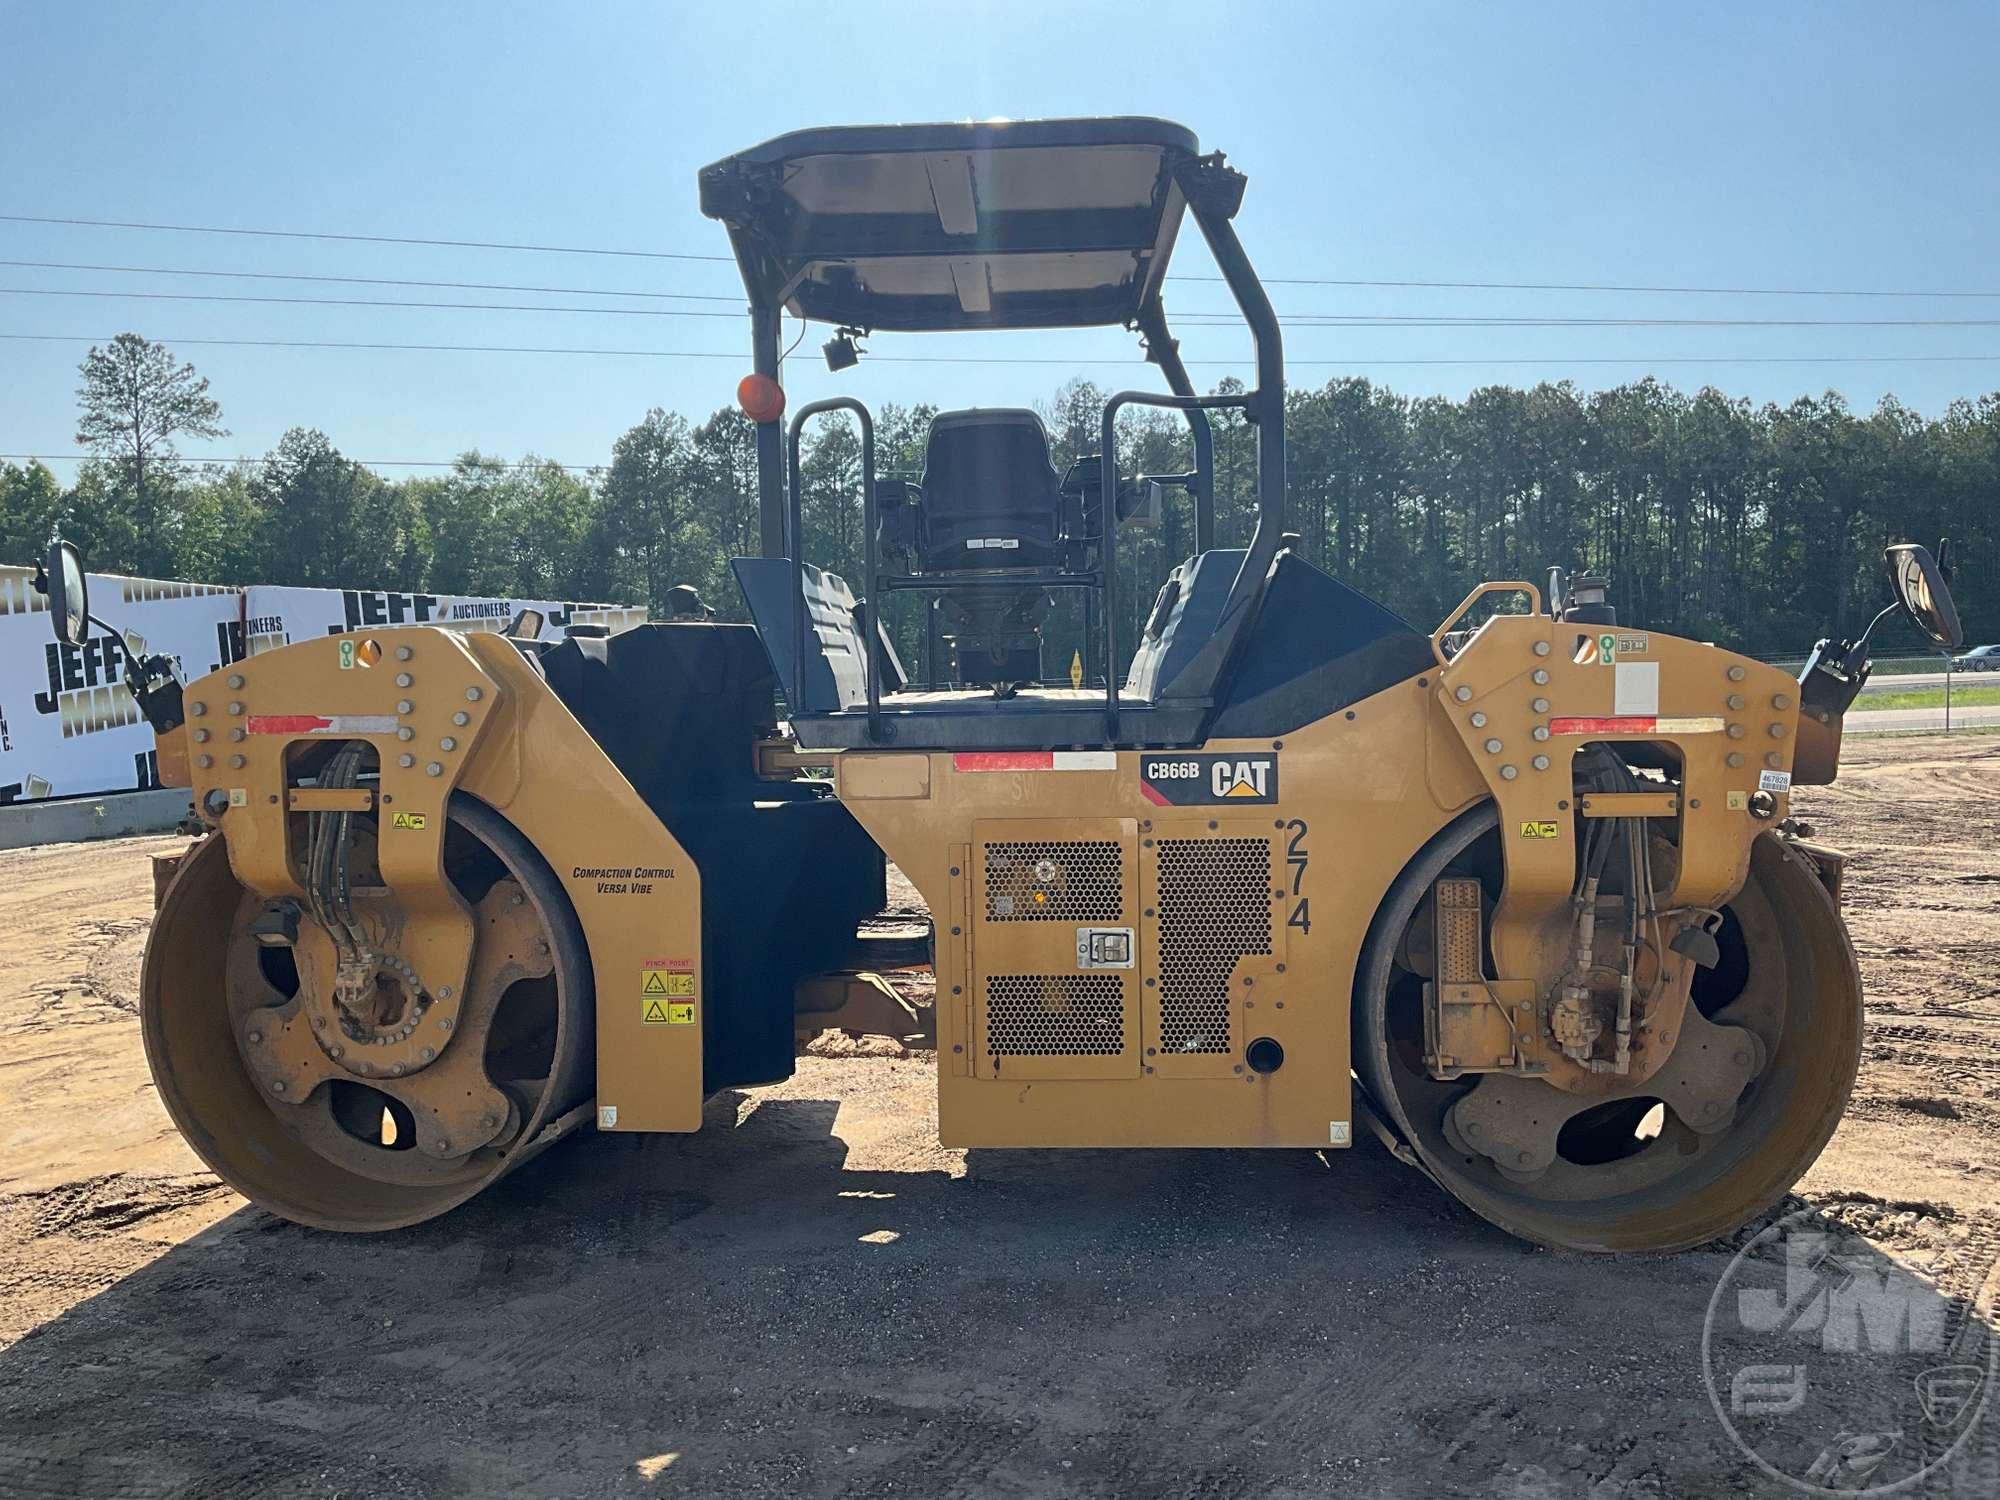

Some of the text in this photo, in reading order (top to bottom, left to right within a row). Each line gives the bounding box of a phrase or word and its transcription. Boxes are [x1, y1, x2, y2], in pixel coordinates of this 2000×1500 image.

[328, 591, 437, 633] JEFF
[453, 603, 511, 619] AUCTIONEERS
[34, 635, 123, 715] JEFF
[1148, 761, 1271, 797] CB66B CAT
[573, 867, 675, 879] COMPACTION CONTROL
[597, 883, 653, 894] VERSA VIBE
